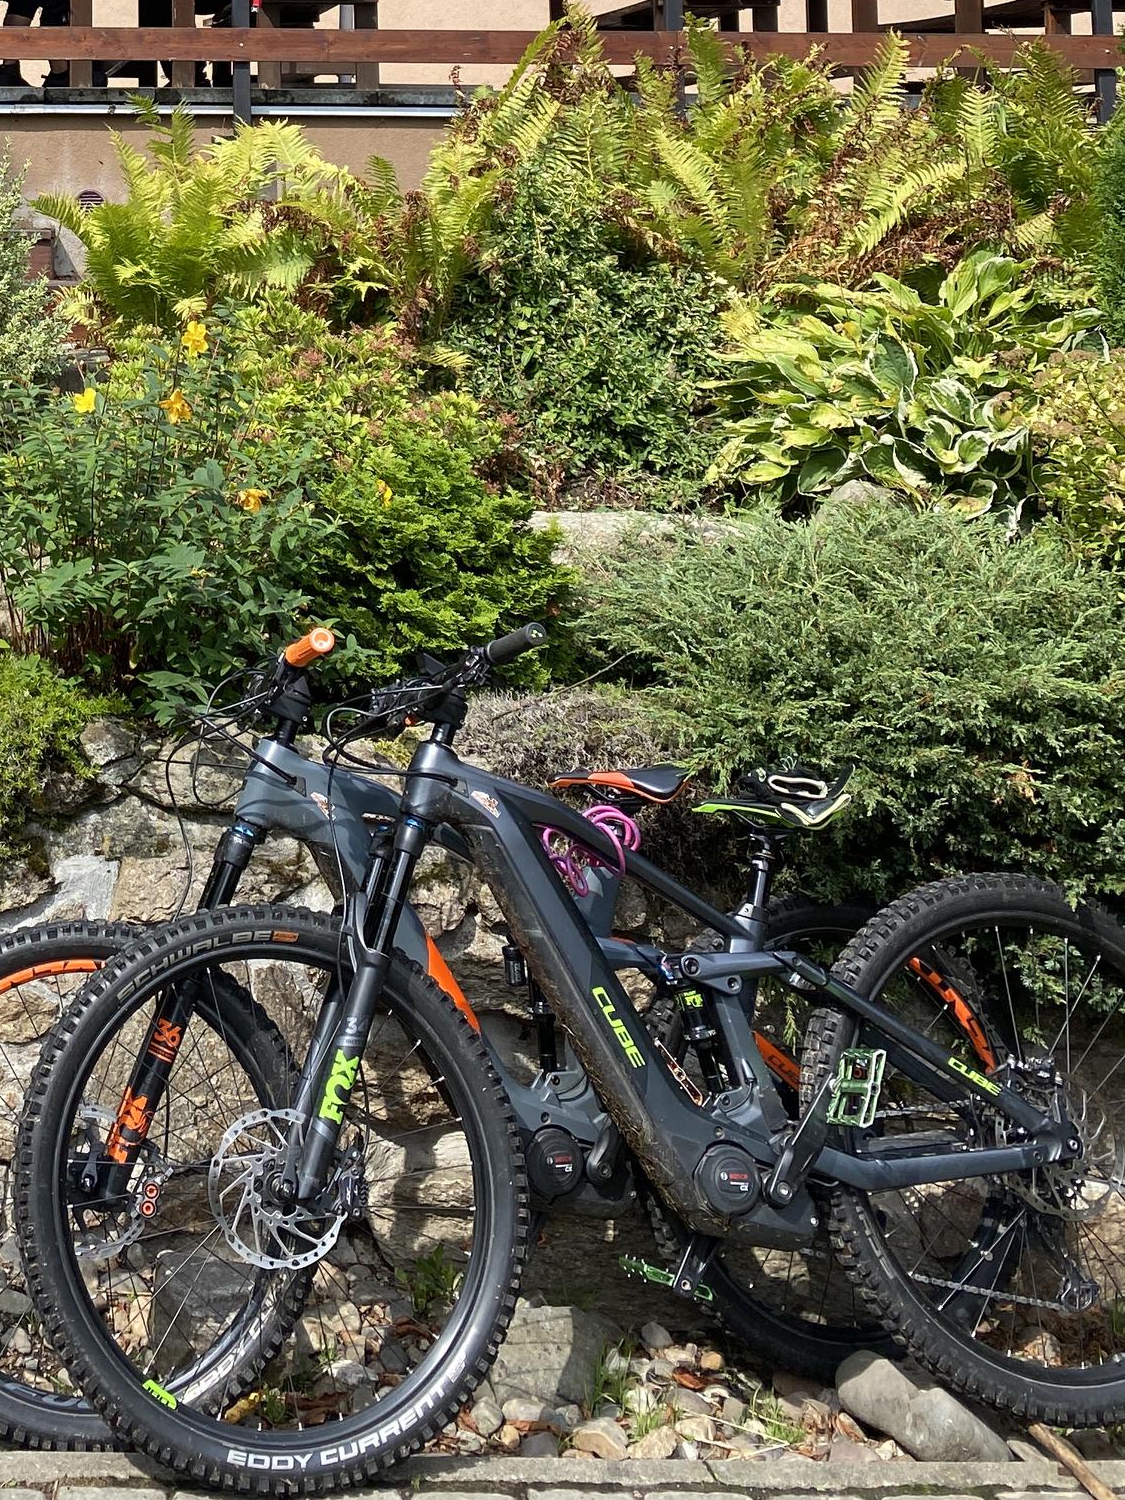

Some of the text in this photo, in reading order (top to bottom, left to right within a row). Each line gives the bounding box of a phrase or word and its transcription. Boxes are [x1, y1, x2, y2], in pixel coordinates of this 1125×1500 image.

[116, 930, 272, 1001] SCHWALBE
[154, 1016, 182, 1048] 36
[591, 986, 646, 1069] CUBE
[318, 1048, 360, 1125] FOX
[947, 1056, 1003, 1097] CUBE
[226, 1381, 446, 1471] EDDY CURRENT
